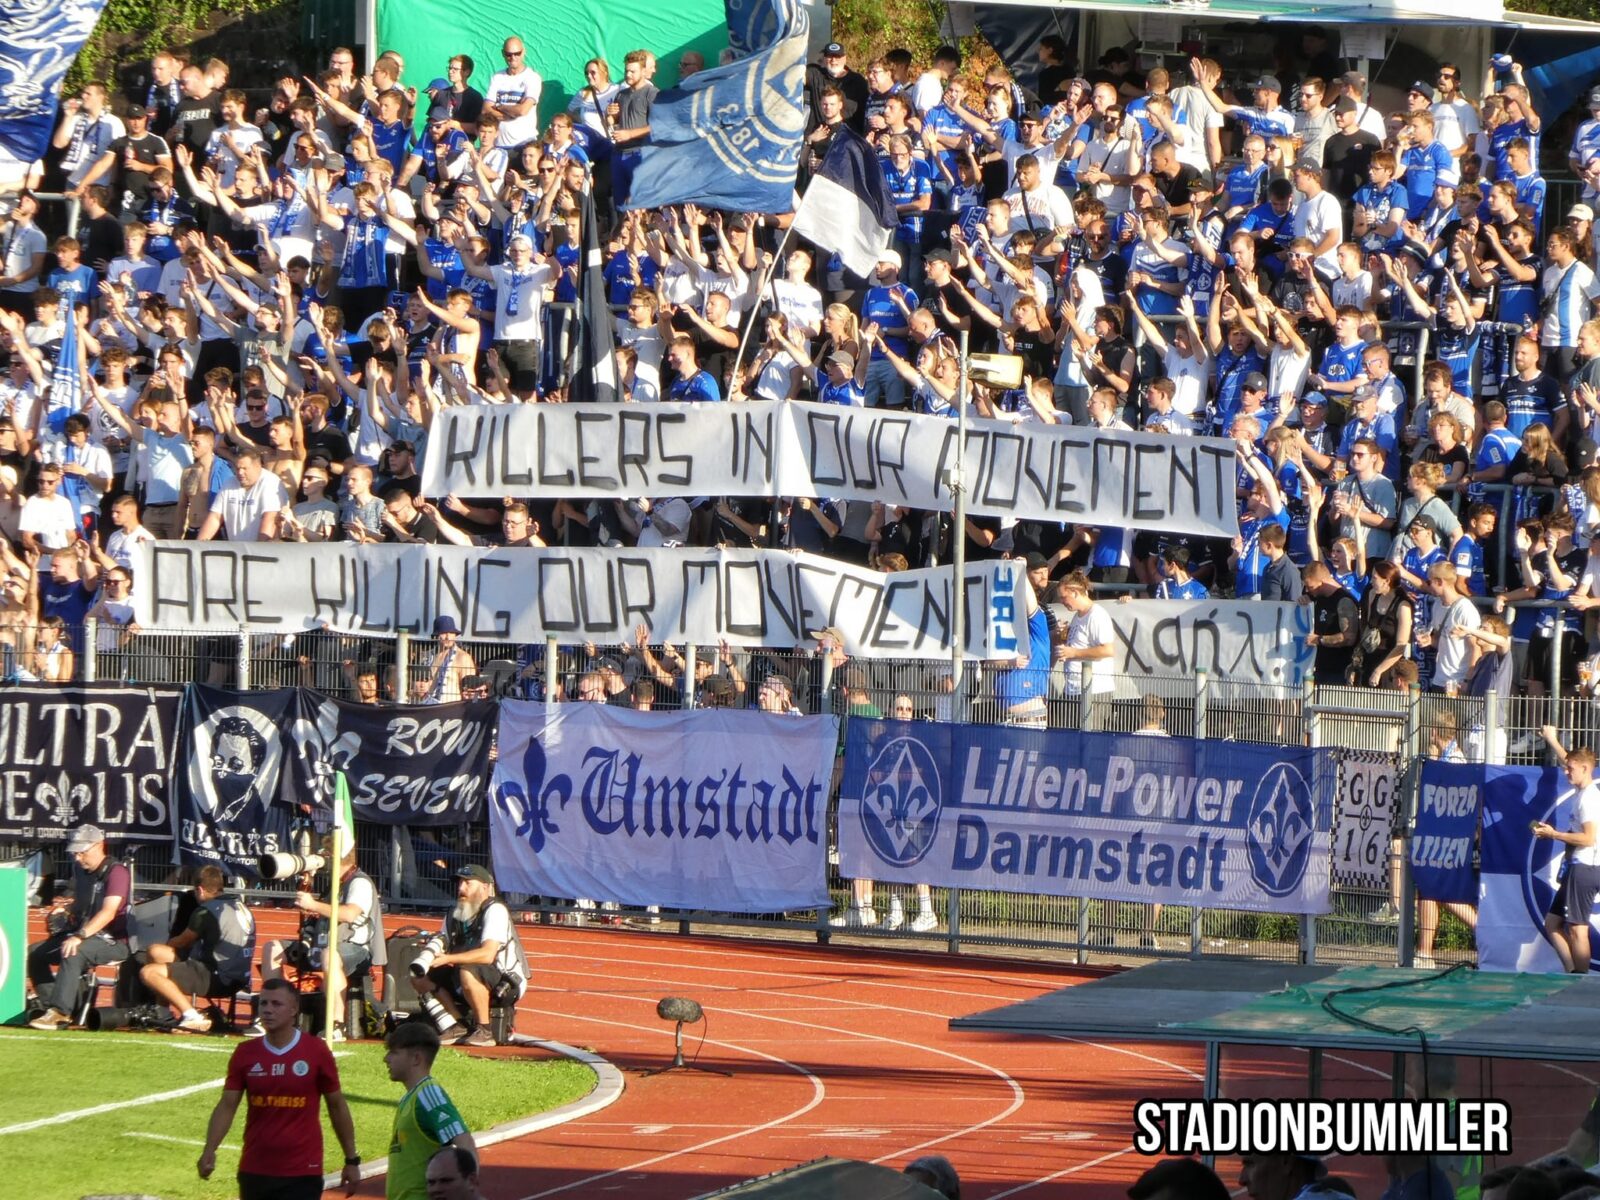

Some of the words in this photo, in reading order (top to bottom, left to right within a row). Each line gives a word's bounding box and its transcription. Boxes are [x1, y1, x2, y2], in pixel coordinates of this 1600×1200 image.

[445, 409, 693, 491] KILLERS
[730, 411, 773, 484] IN
[808, 411, 911, 501] OUR
[934, 425, 1235, 521] MOVEMENT
[151, 546, 283, 624] ARE
[310, 552, 512, 638] KILLING
[537, 557, 656, 632] OUR
[384, 716, 483, 758] ROW
[0, 770, 33, 821] E
[95, 772, 165, 828] LIS
[353, 772, 482, 814] SEVEN
[581, 745, 823, 845] Umstadt
[959, 745, 1244, 823] Lilien-Power
[1423, 783, 1479, 818] FORZA
[951, 813, 1228, 893] Darmstadt
[1411, 835, 1471, 870] LILIEN
[271, 1063, 286, 1076] EM
